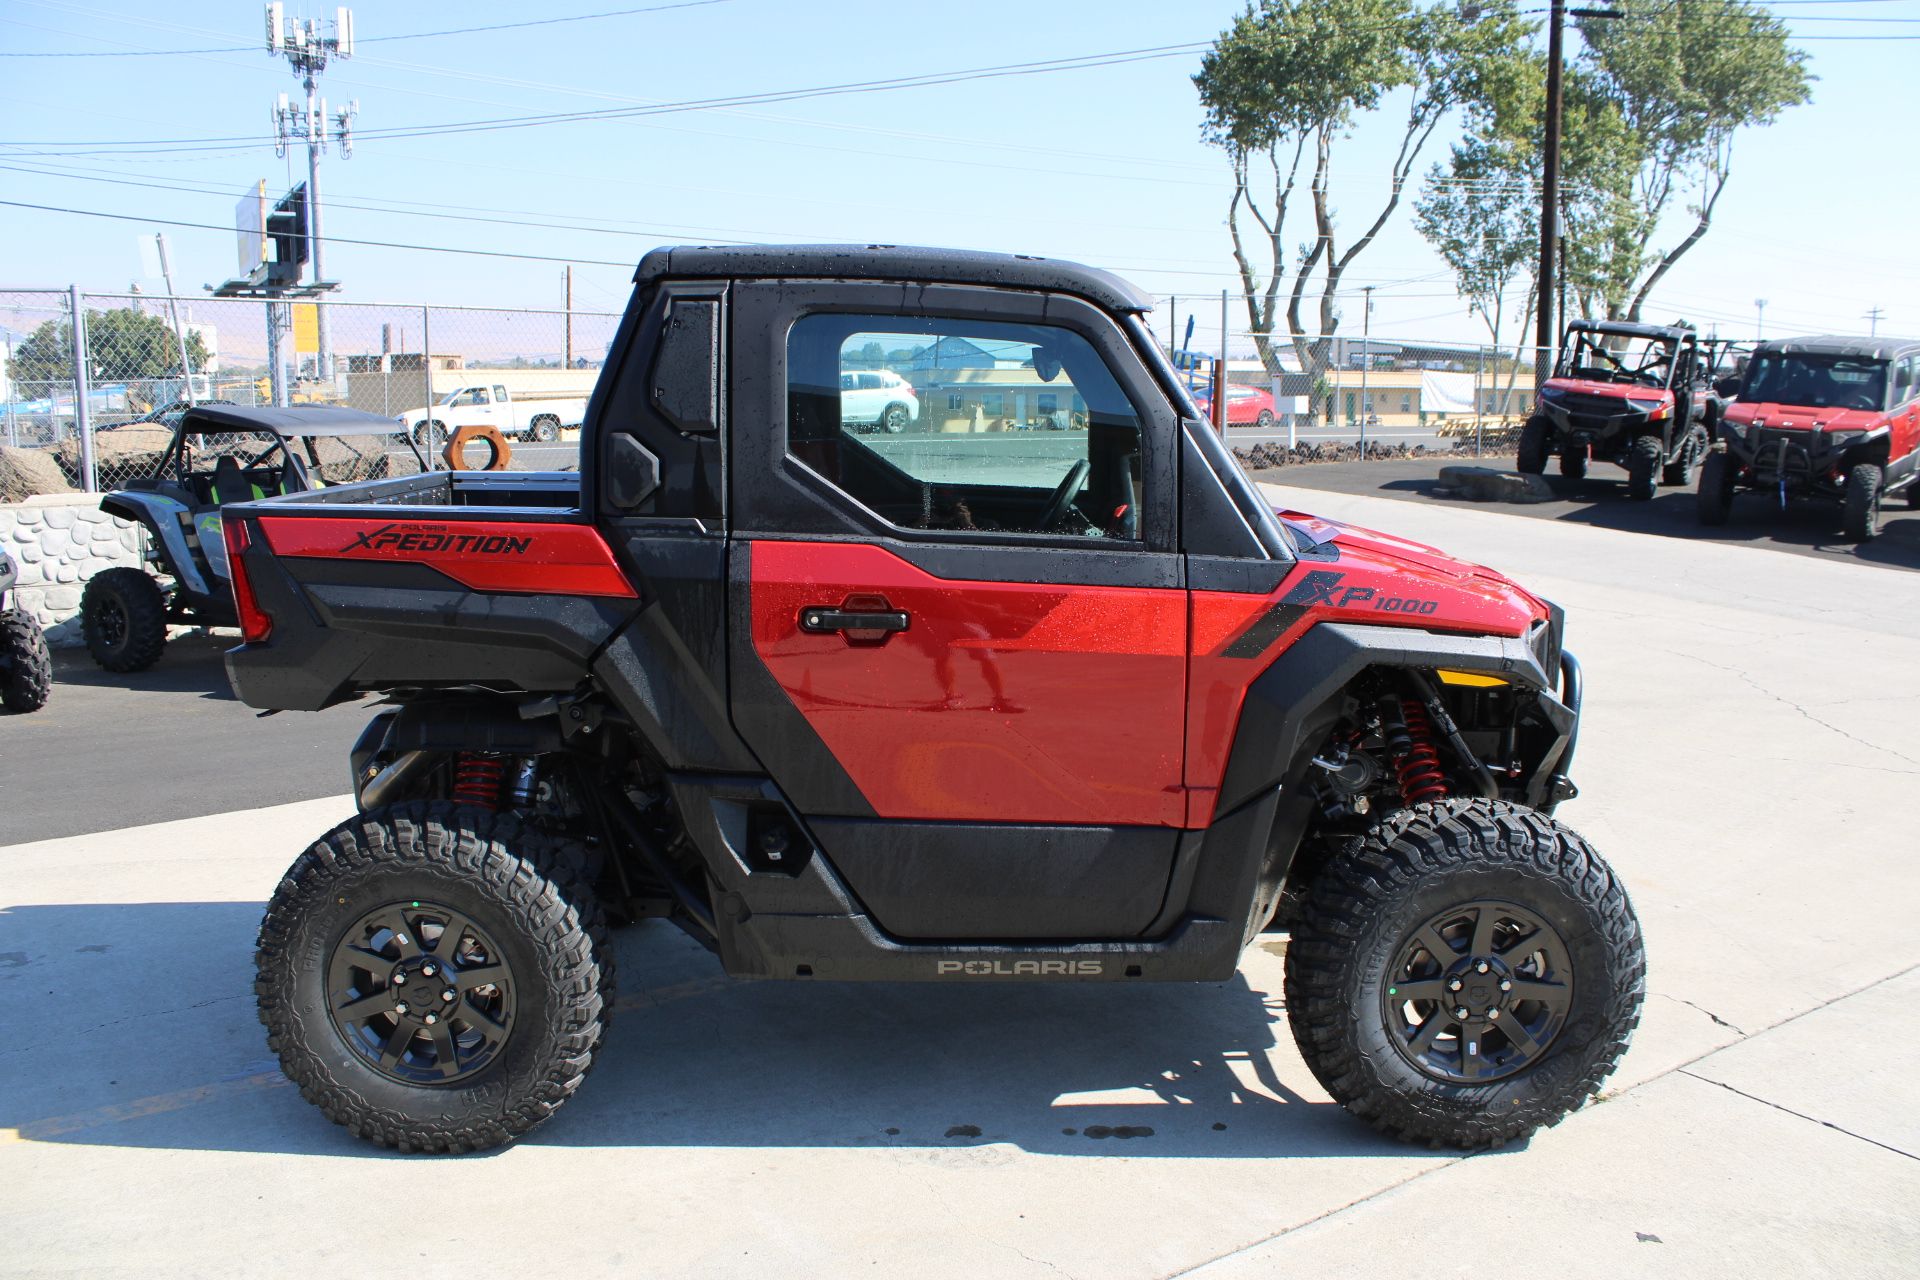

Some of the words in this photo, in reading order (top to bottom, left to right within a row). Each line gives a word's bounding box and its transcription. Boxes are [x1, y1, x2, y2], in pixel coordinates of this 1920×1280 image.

[338, 523, 532, 554] XPEDITION
[400, 523, 448, 533] POLARIS
[1301, 582, 1375, 607] XP
[1374, 596, 1438, 614] 1000
[937, 960, 1103, 975] POLARIS
